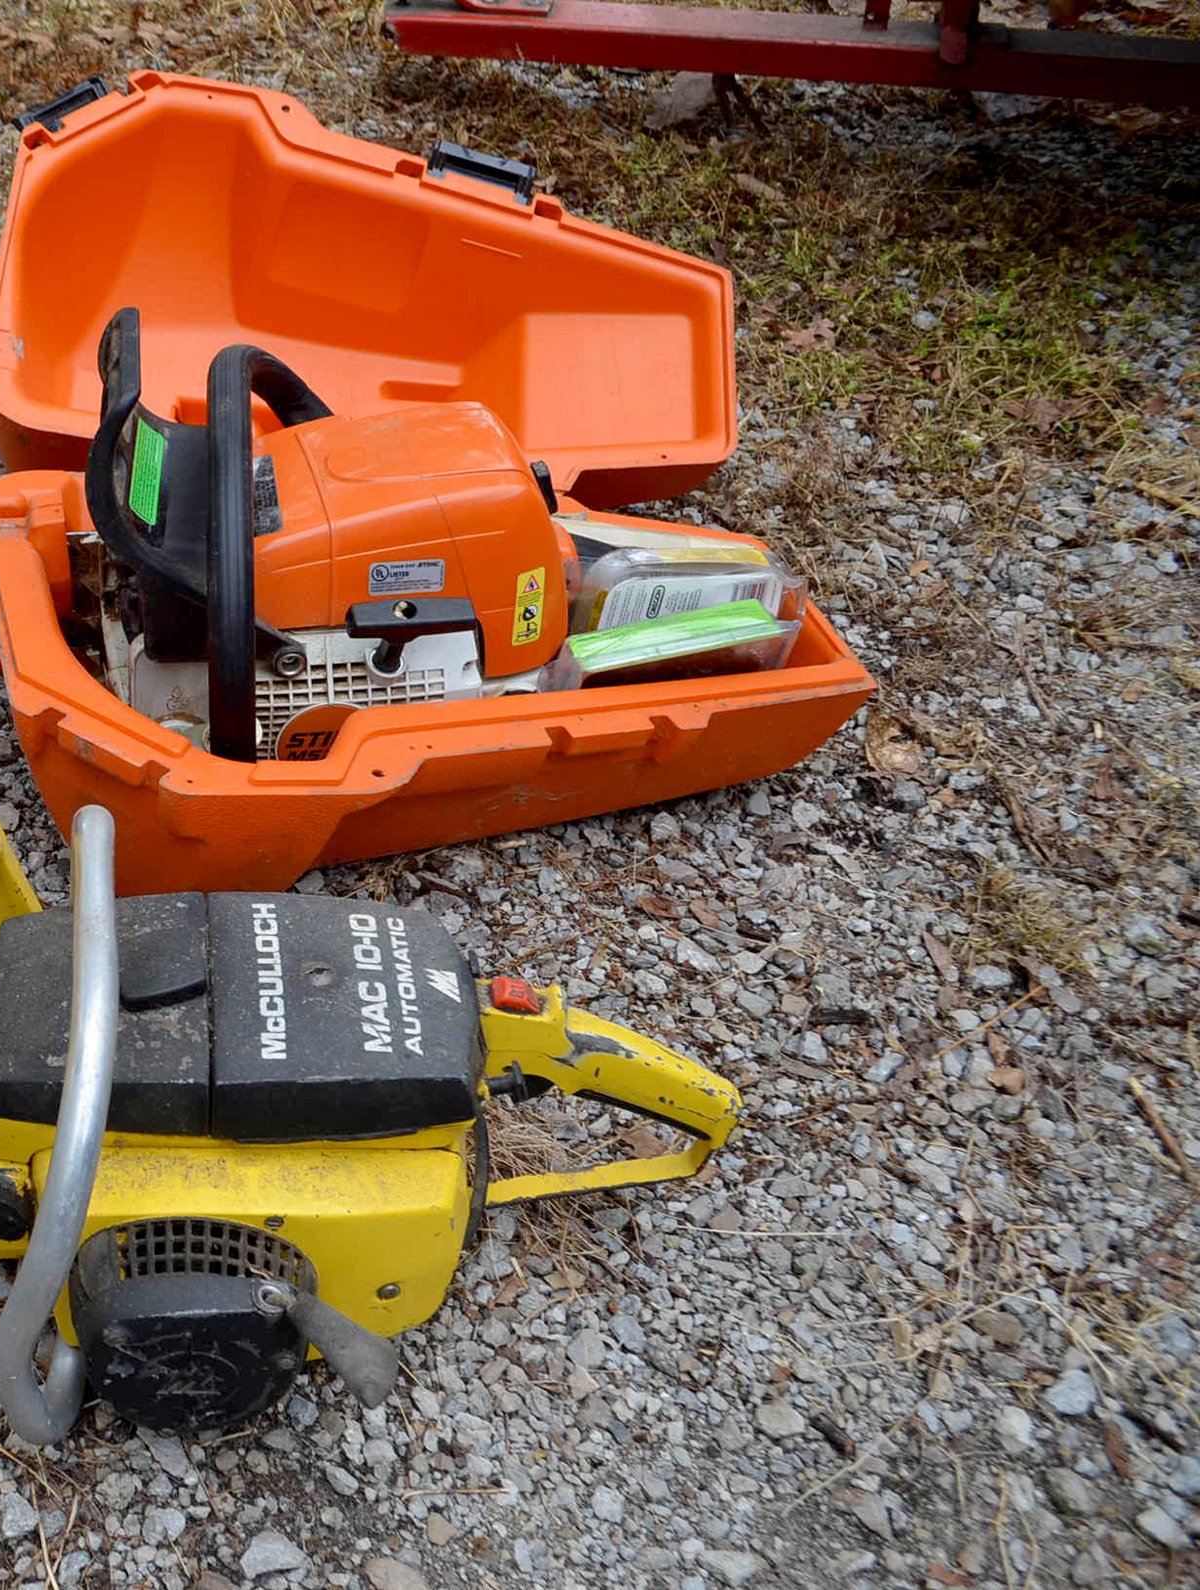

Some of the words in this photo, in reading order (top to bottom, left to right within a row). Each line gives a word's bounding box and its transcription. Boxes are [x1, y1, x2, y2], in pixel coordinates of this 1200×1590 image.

[286, 730, 338, 749] STI
[348, 913, 384, 972] 10-10
[251, 902, 288, 1060] McCULLOCH
[357, 980, 394, 1053] MAC
[386, 917, 425, 1057] AUTOMATIC
